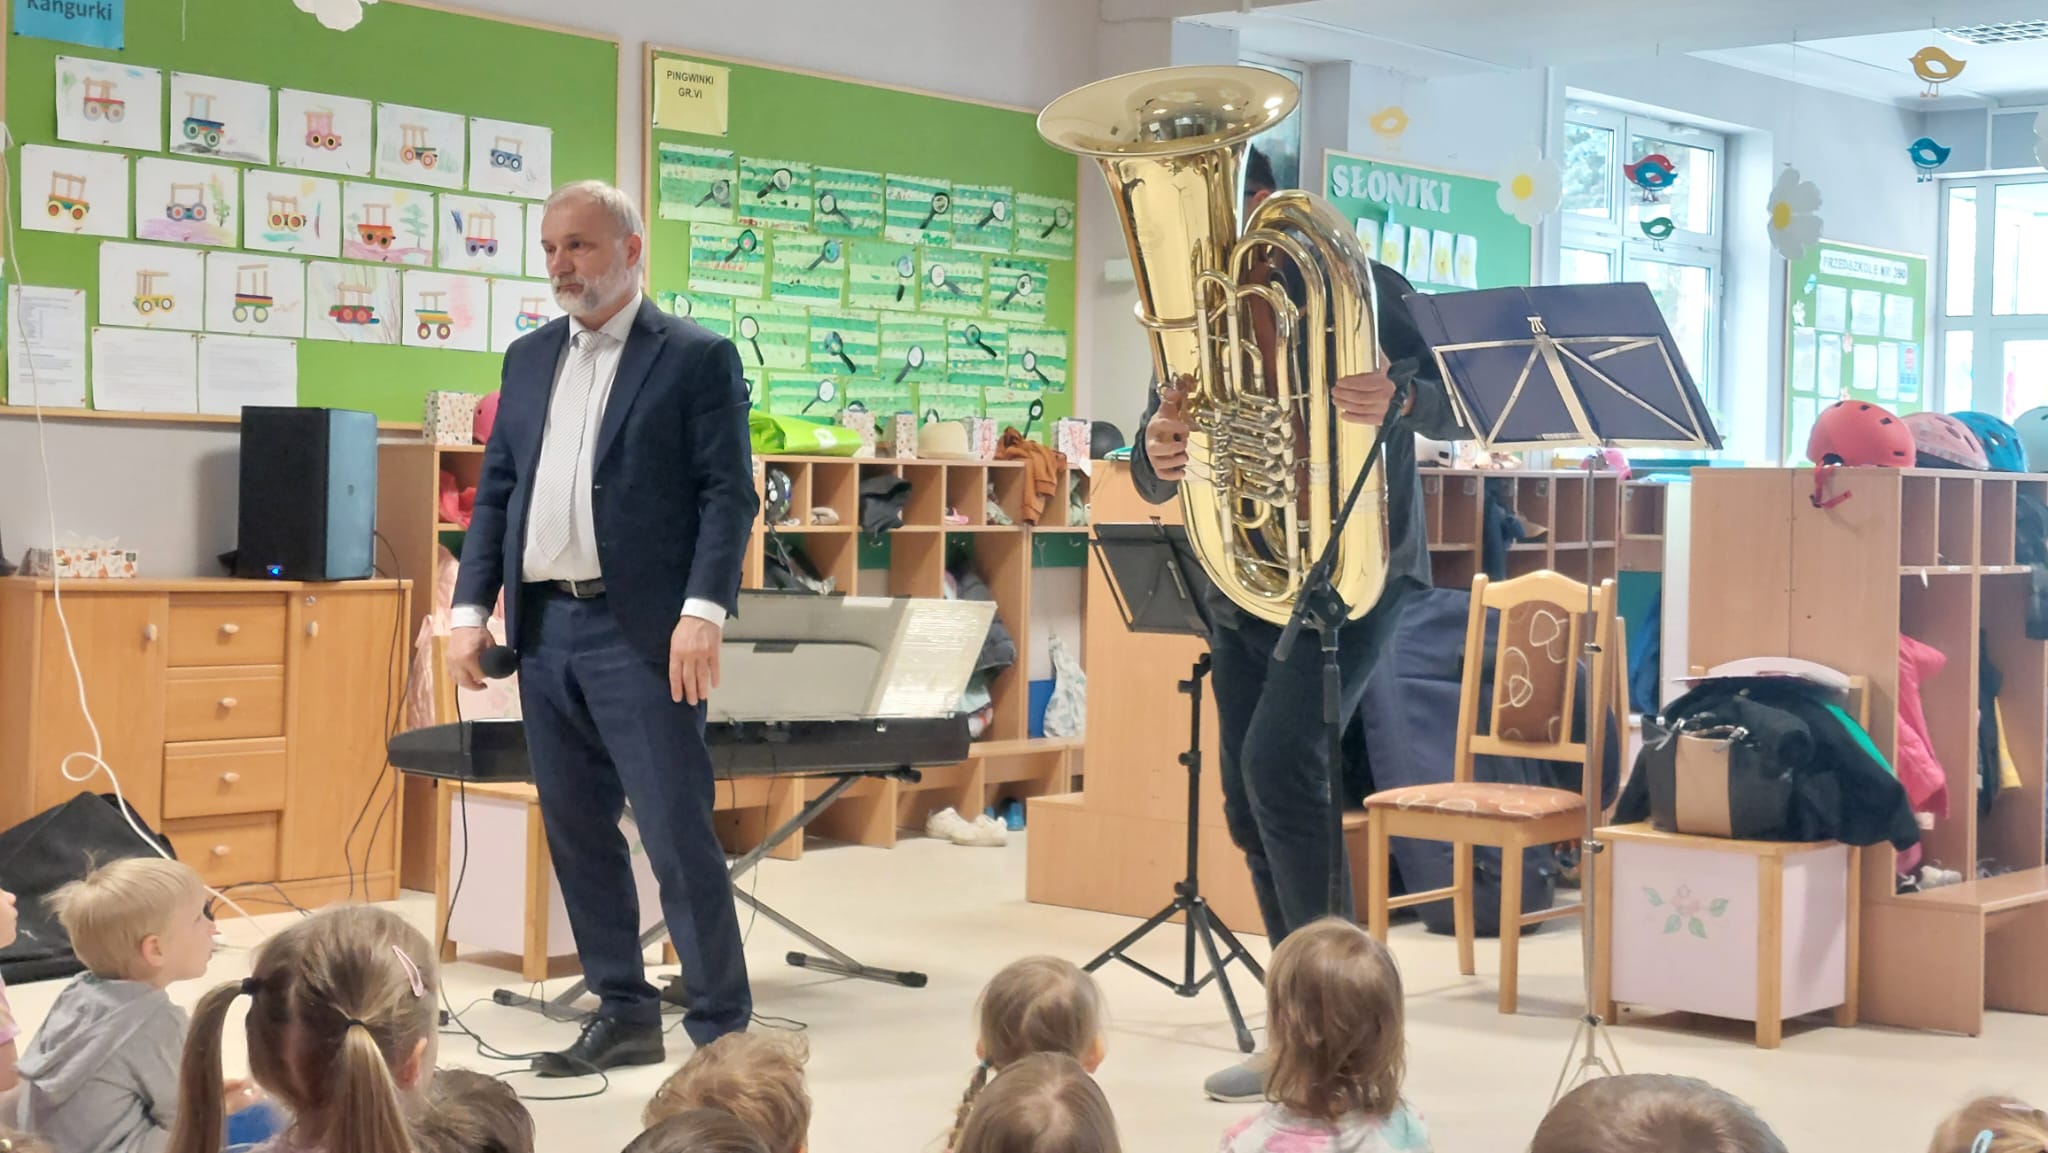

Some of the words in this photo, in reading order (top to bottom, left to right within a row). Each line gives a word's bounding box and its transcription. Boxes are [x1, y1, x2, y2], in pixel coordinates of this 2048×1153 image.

[666, 70, 714, 85] PINGWINKI
[1332, 164, 1452, 214] SŁONIKI
[1823, 256, 1878, 275] PRZEDSZKOLE
